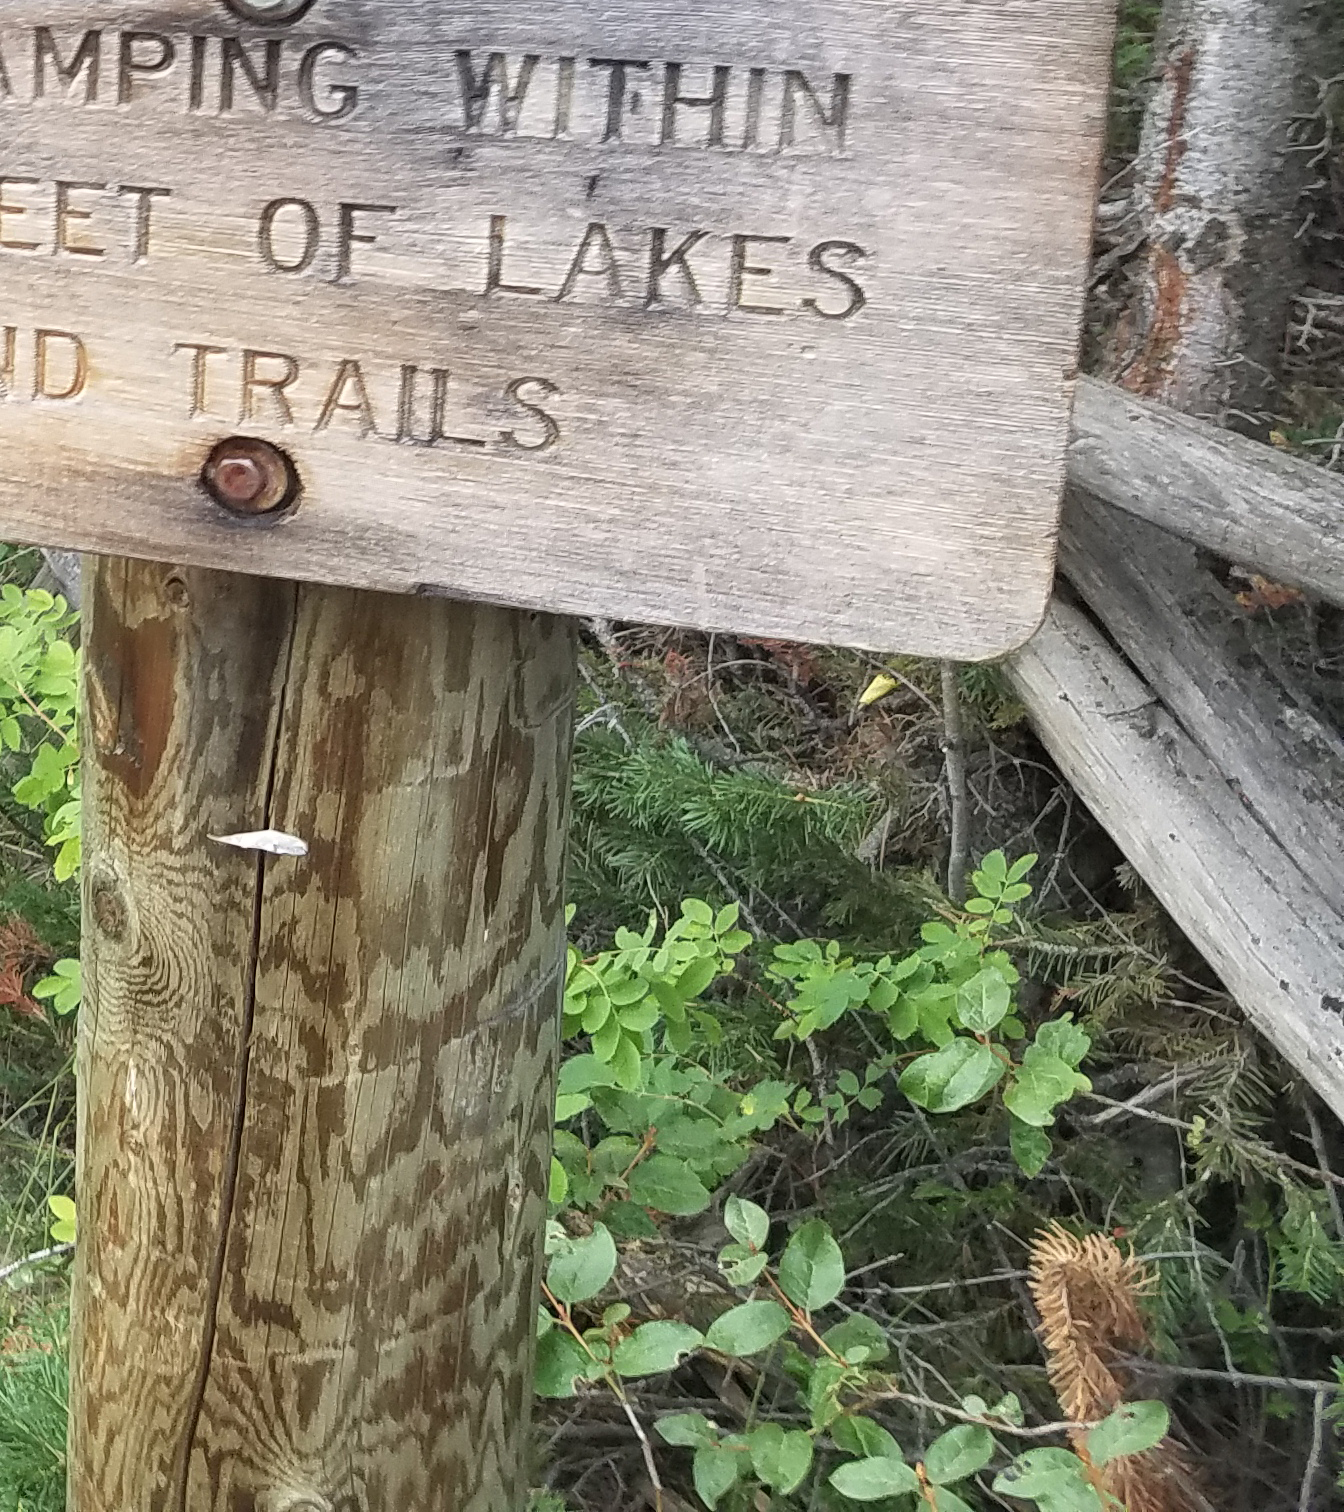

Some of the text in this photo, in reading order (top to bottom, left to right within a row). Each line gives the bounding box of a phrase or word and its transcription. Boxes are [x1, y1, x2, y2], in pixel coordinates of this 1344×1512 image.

[452, 48, 855, 152] WITHIN
[257, 196, 399, 286] OF
[484, 214, 870, 322] LAKES
[172, 342, 564, 452] TRAILS
